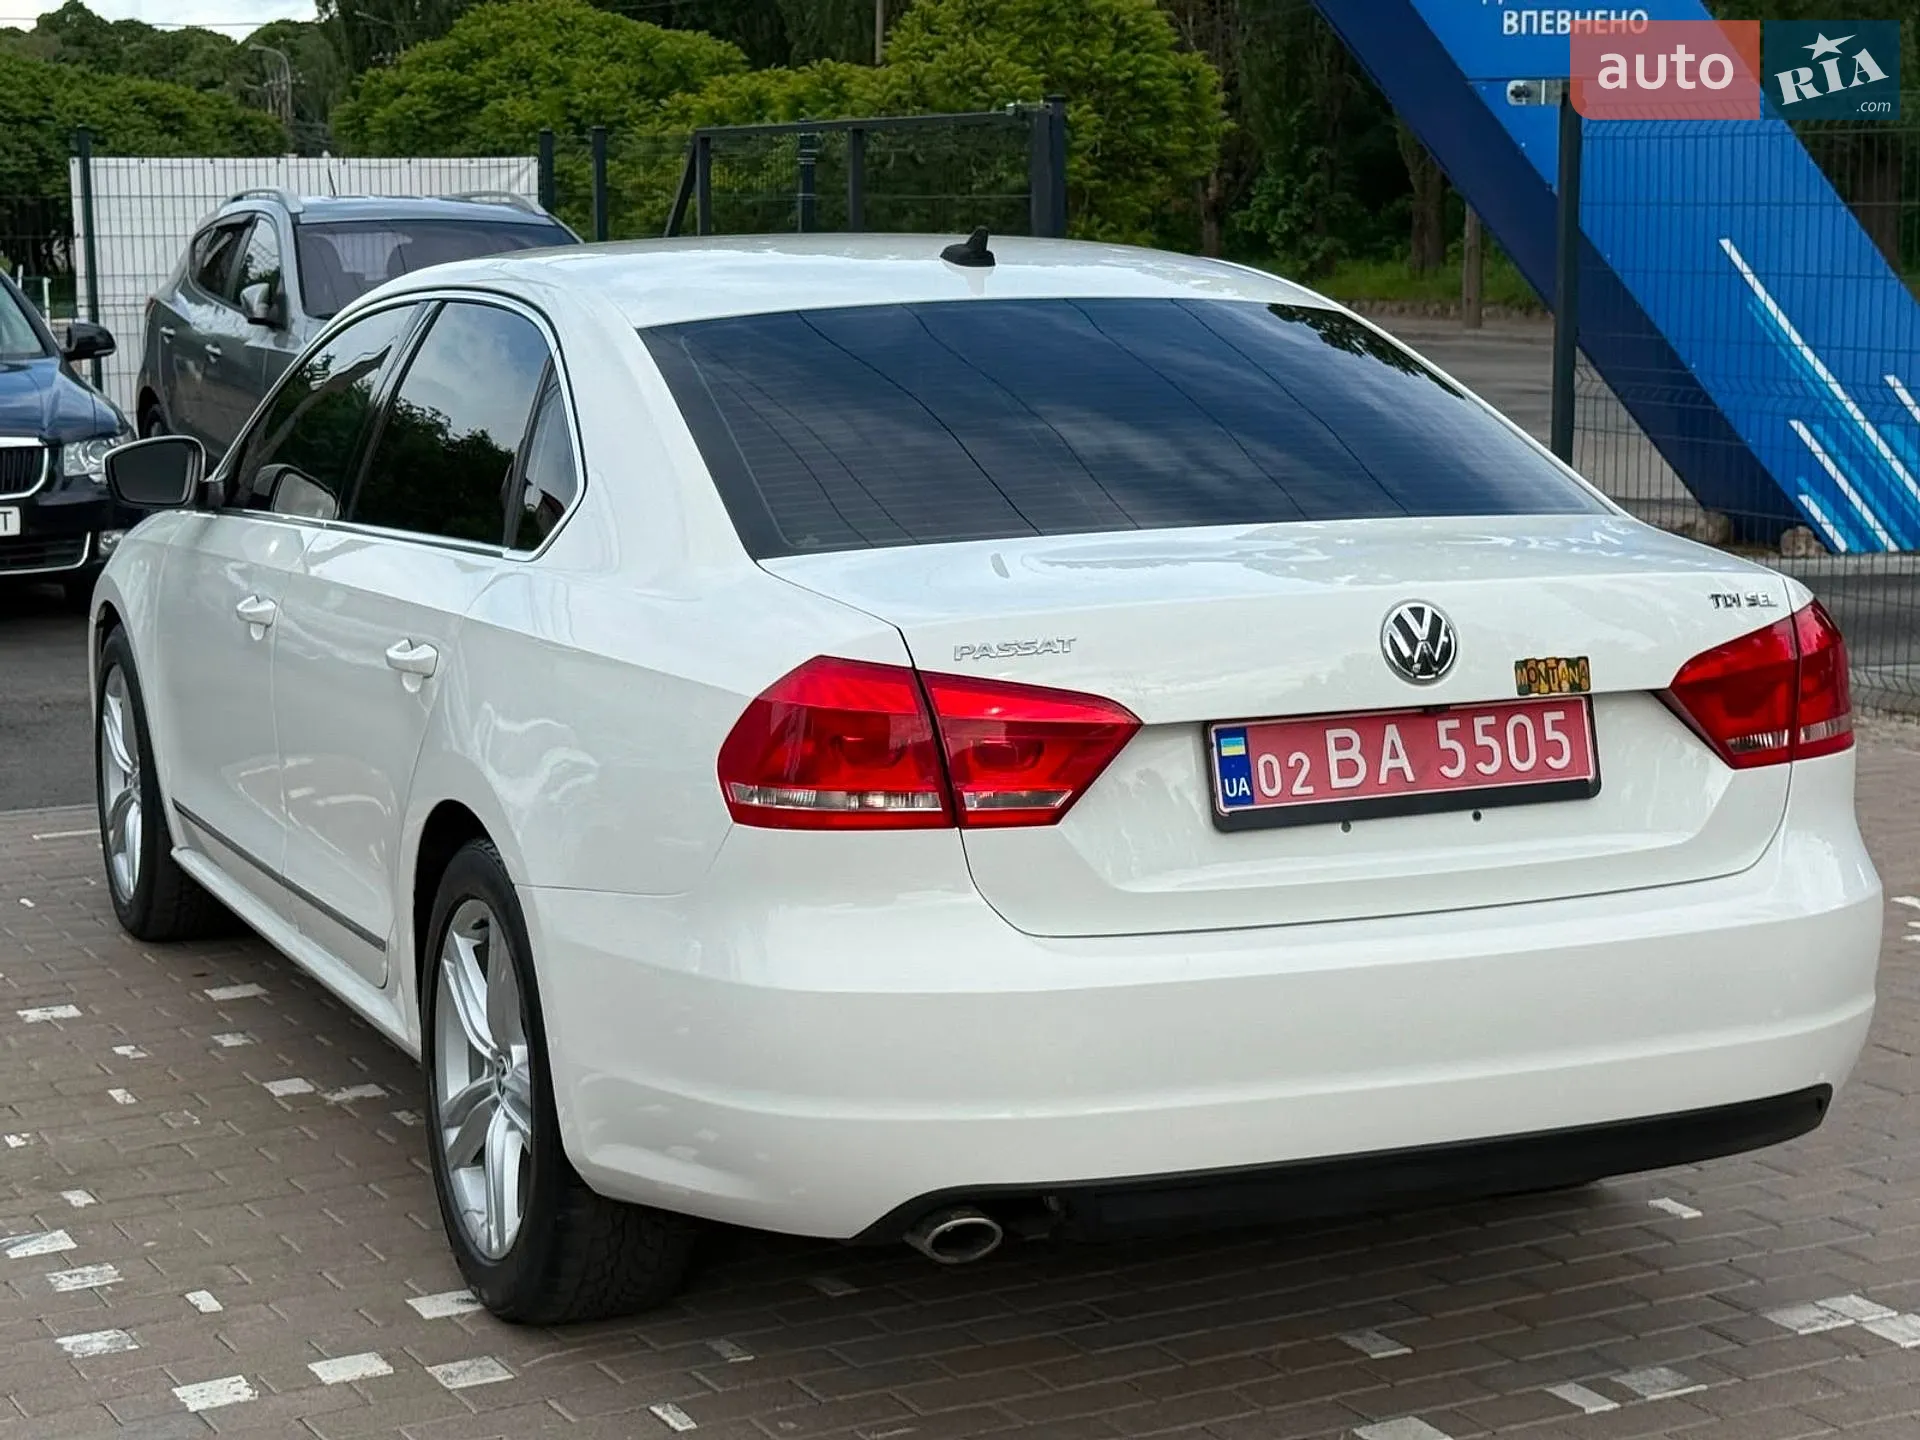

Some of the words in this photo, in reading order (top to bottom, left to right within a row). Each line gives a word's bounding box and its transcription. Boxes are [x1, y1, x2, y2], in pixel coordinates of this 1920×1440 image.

[1502, 9, 1649, 35] ВПЕВНЕНО
[1709, 593, 1741, 609] TDI
[954, 637, 1077, 661] PASSAT
[1382, 601, 1457, 681] VW
[1515, 657, 1591, 694] MONTANA
[1257, 751, 1315, 798] 02
[1325, 723, 1416, 790] BA
[1436, 710, 1571, 779] 5505
[1224, 777, 1251, 798] UA
